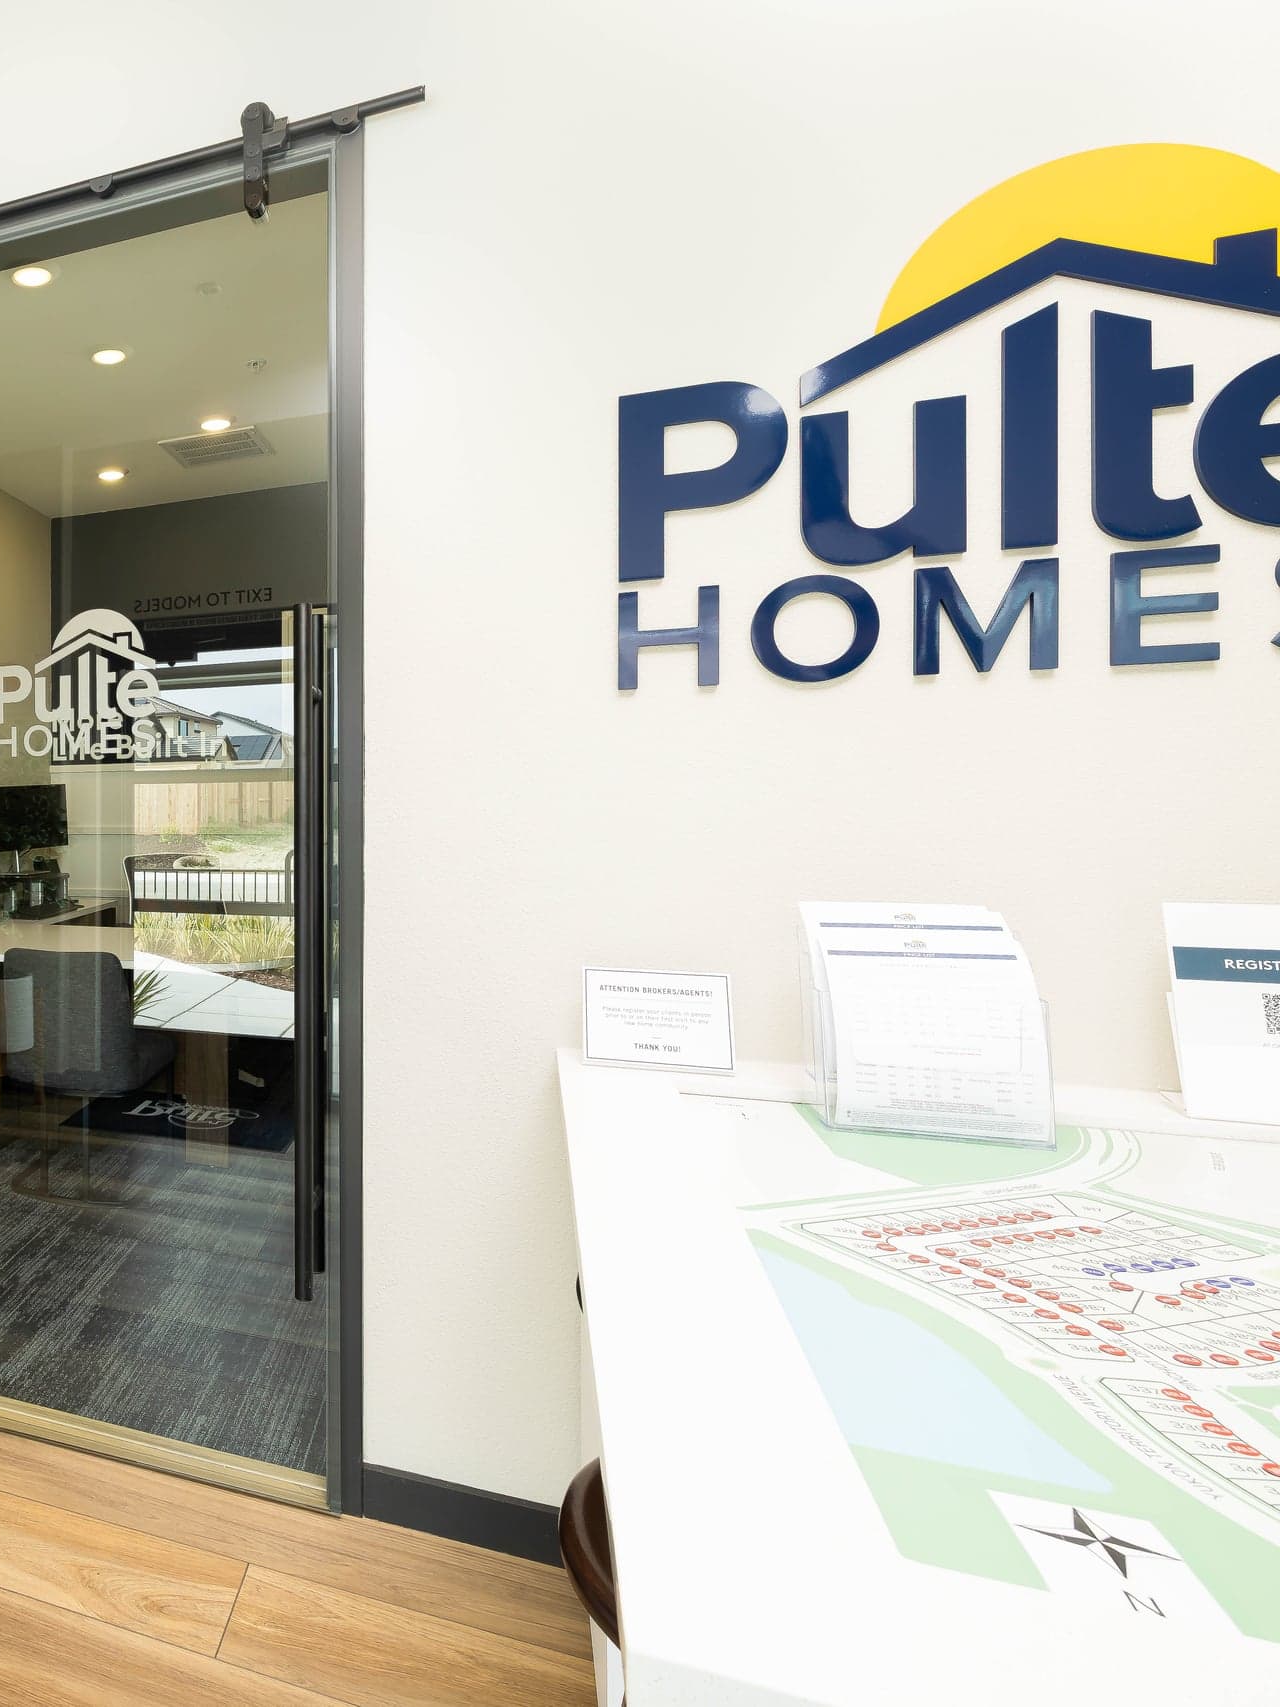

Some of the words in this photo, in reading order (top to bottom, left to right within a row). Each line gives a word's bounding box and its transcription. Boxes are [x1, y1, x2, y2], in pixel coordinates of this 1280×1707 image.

[619, 544, 1280, 690] HOME
[599, 984, 640, 993] ATTENTION
[642, 986, 713, 998] BROKERS/AGENTS!
[633, 1042, 660, 1052] THANK
[662, 1044, 681, 1053] YOU!
